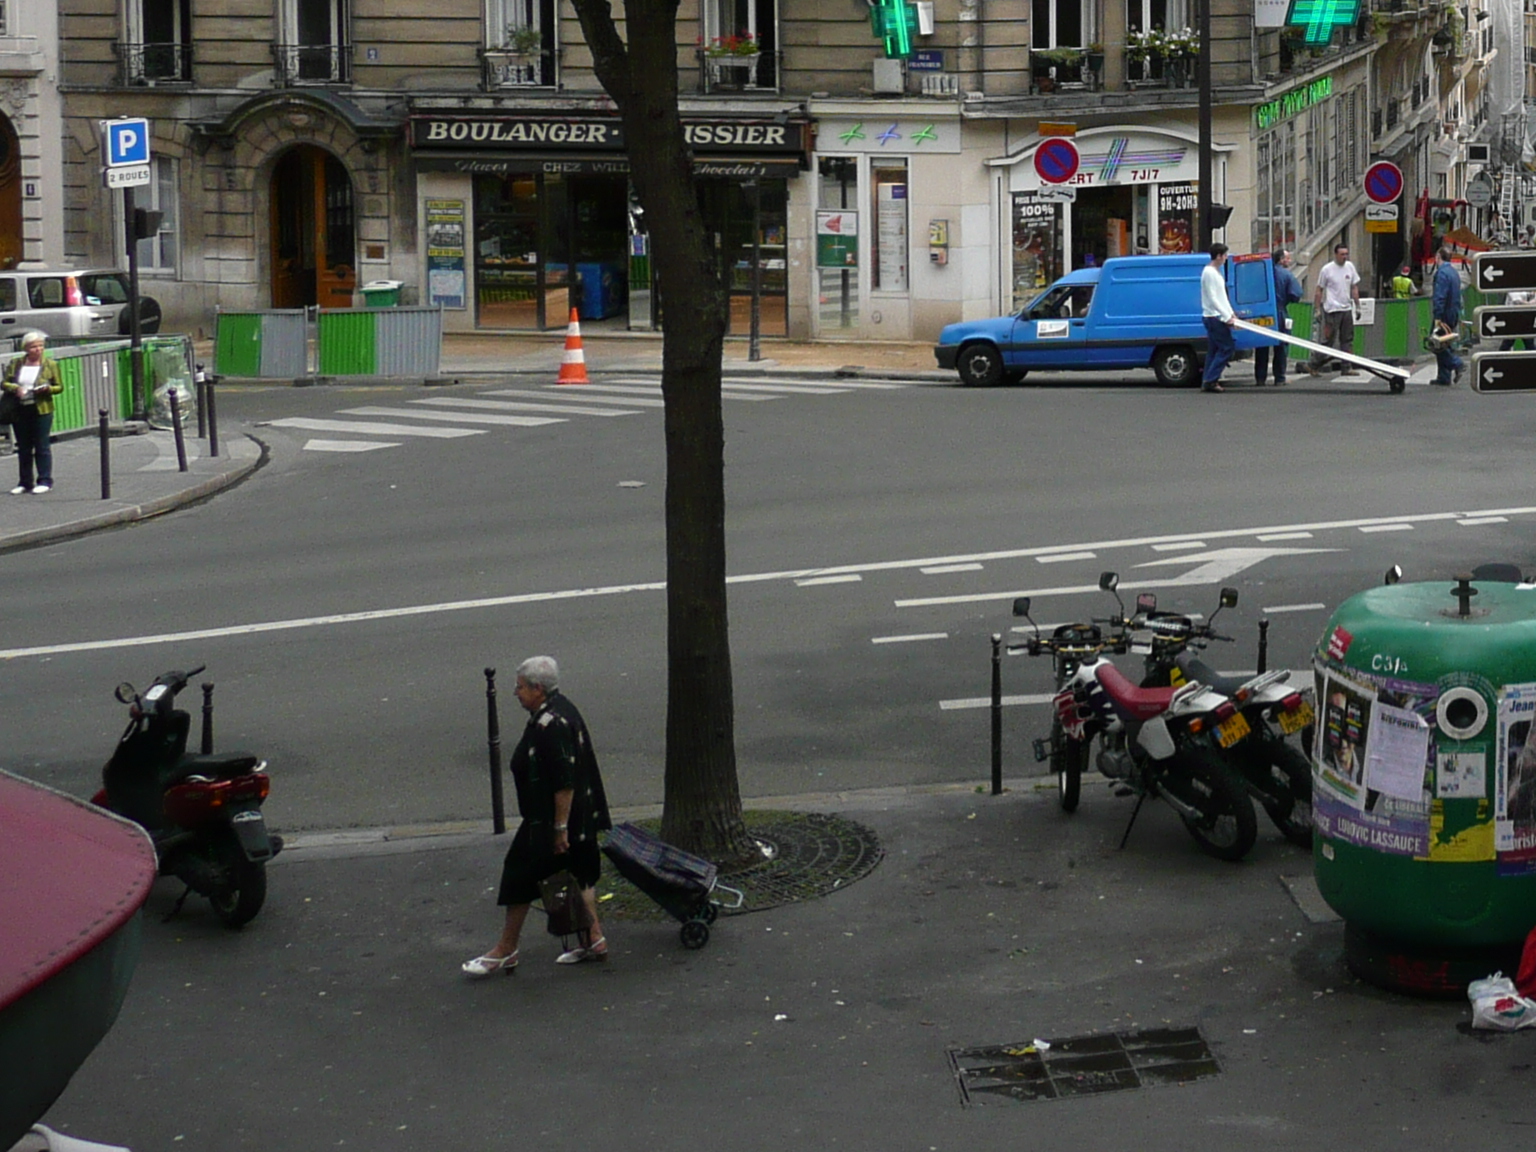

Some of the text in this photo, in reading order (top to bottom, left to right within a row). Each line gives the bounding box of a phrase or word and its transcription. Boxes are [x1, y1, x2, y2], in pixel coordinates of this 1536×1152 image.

[427, 121, 607, 143] BOULANGER
[119, 129, 138, 157] P
[110, 169, 149, 183] 2 ROUES
[542, 162, 582, 173] CHEZ
[1020, 204, 1055, 217] 100%
[1337, 816, 1369, 842] LUDOVIC
[1371, 829, 1422, 853] LASSAUCE
